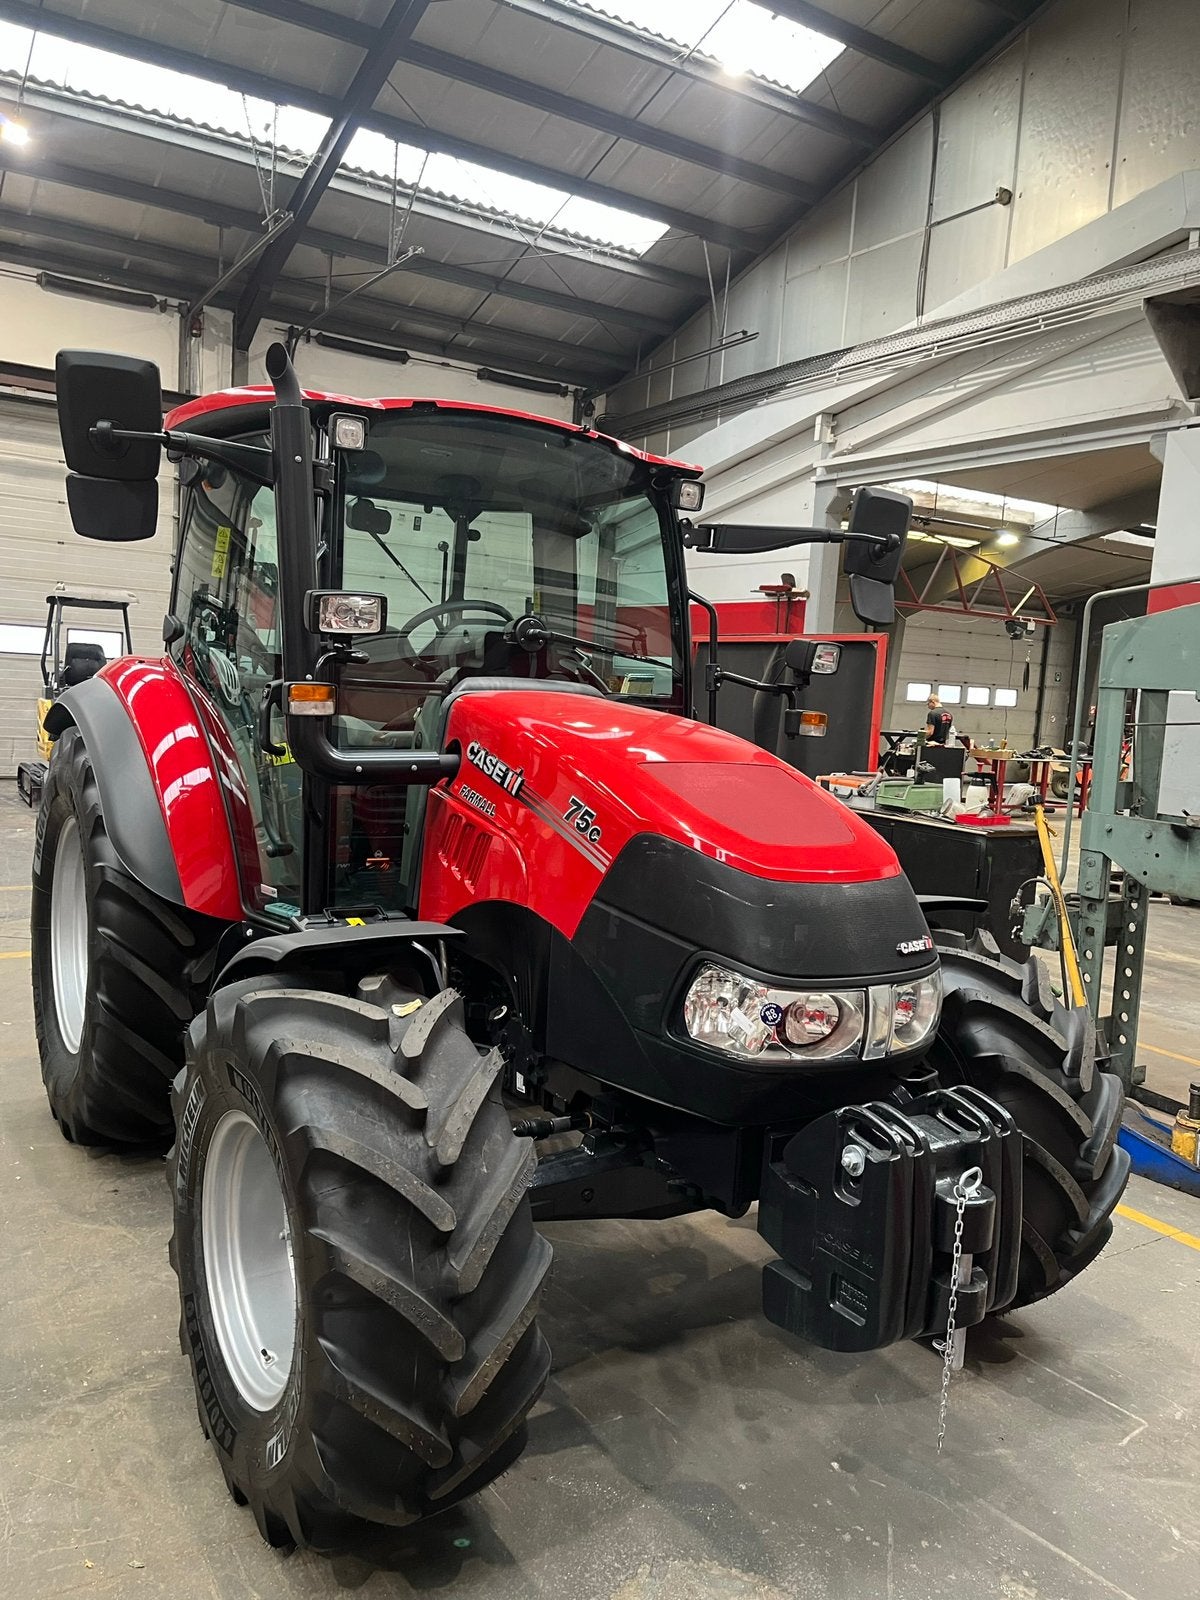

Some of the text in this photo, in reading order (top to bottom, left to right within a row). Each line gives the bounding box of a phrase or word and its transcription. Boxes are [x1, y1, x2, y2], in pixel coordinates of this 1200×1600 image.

[467, 741, 508, 783] CASE
[460, 785, 496, 817] FARMALL
[900, 939, 925, 954] CASE
[179, 1076, 206, 1180] MICHELIN
